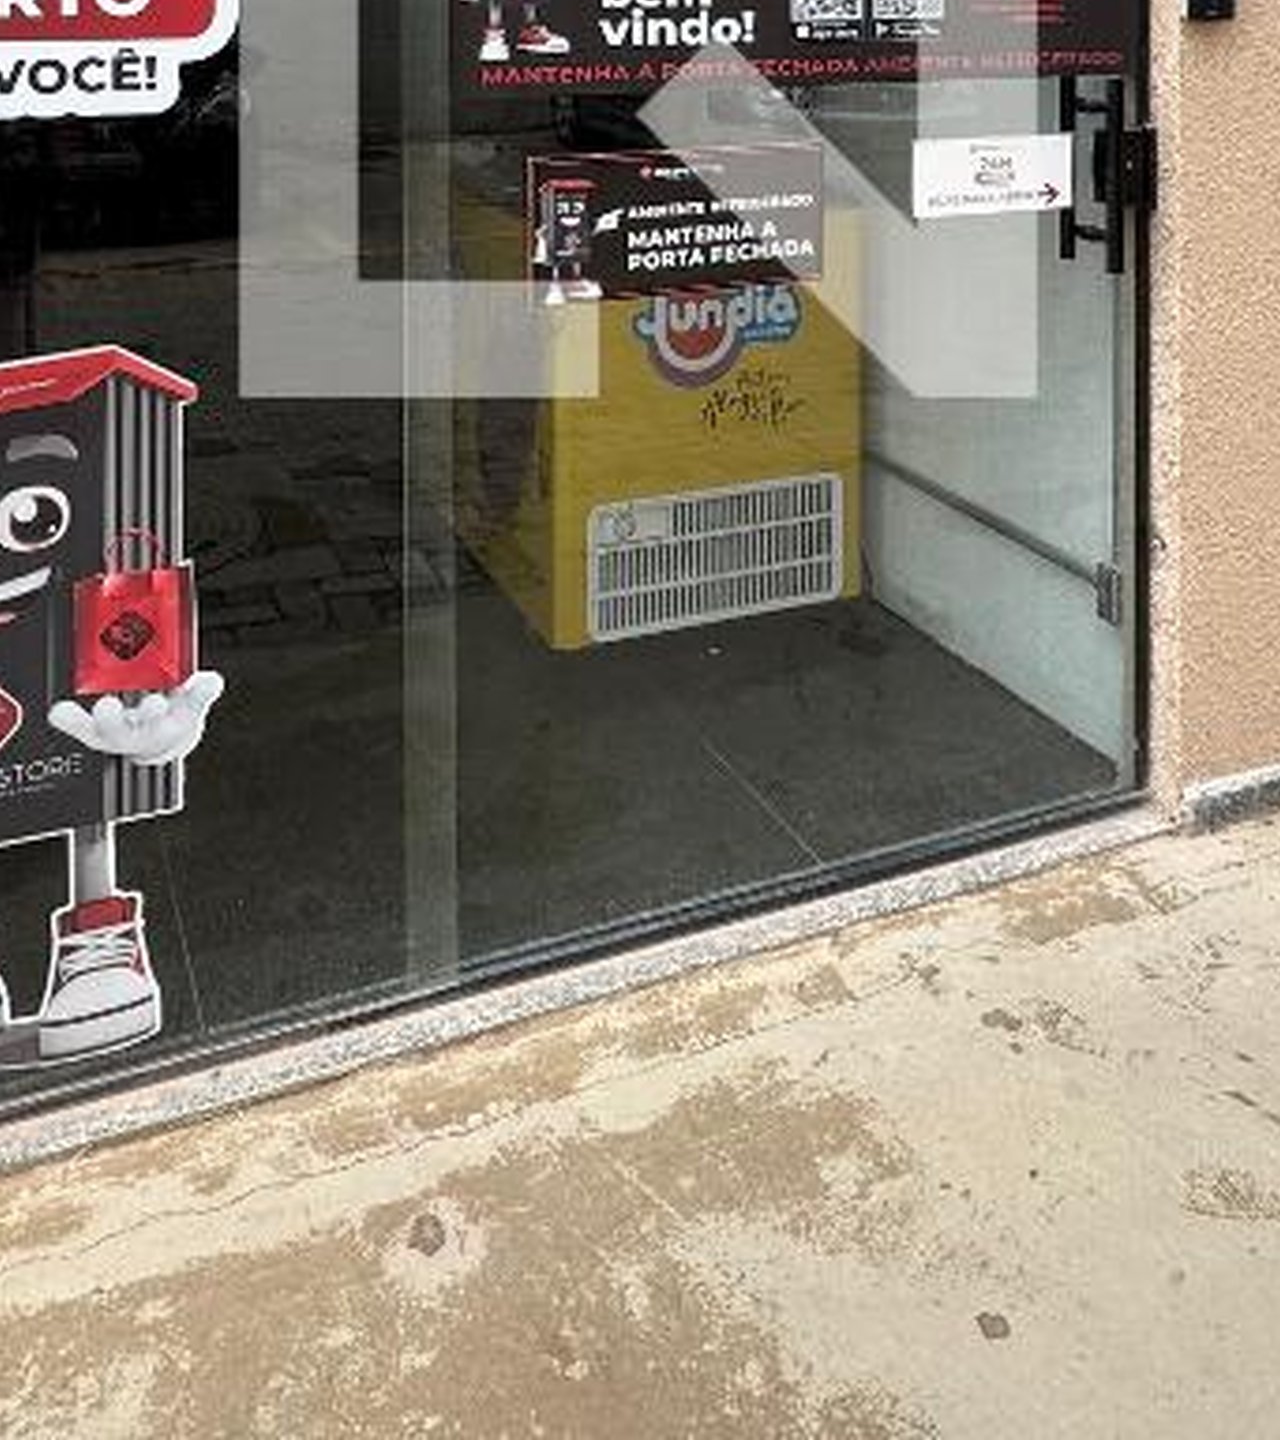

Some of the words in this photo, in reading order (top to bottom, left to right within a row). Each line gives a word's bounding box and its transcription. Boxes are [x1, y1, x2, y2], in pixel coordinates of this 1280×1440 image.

[598, 7, 756, 46] vindo!
[481, 64, 630, 86] MANTENHA
[639, 62, 655, 79] A
[627, 221, 754, 248] MANTENHA
[761, 220, 778, 237] A
[627, 247, 706, 271] PORTA
[710, 239, 815, 263] FECHADA
